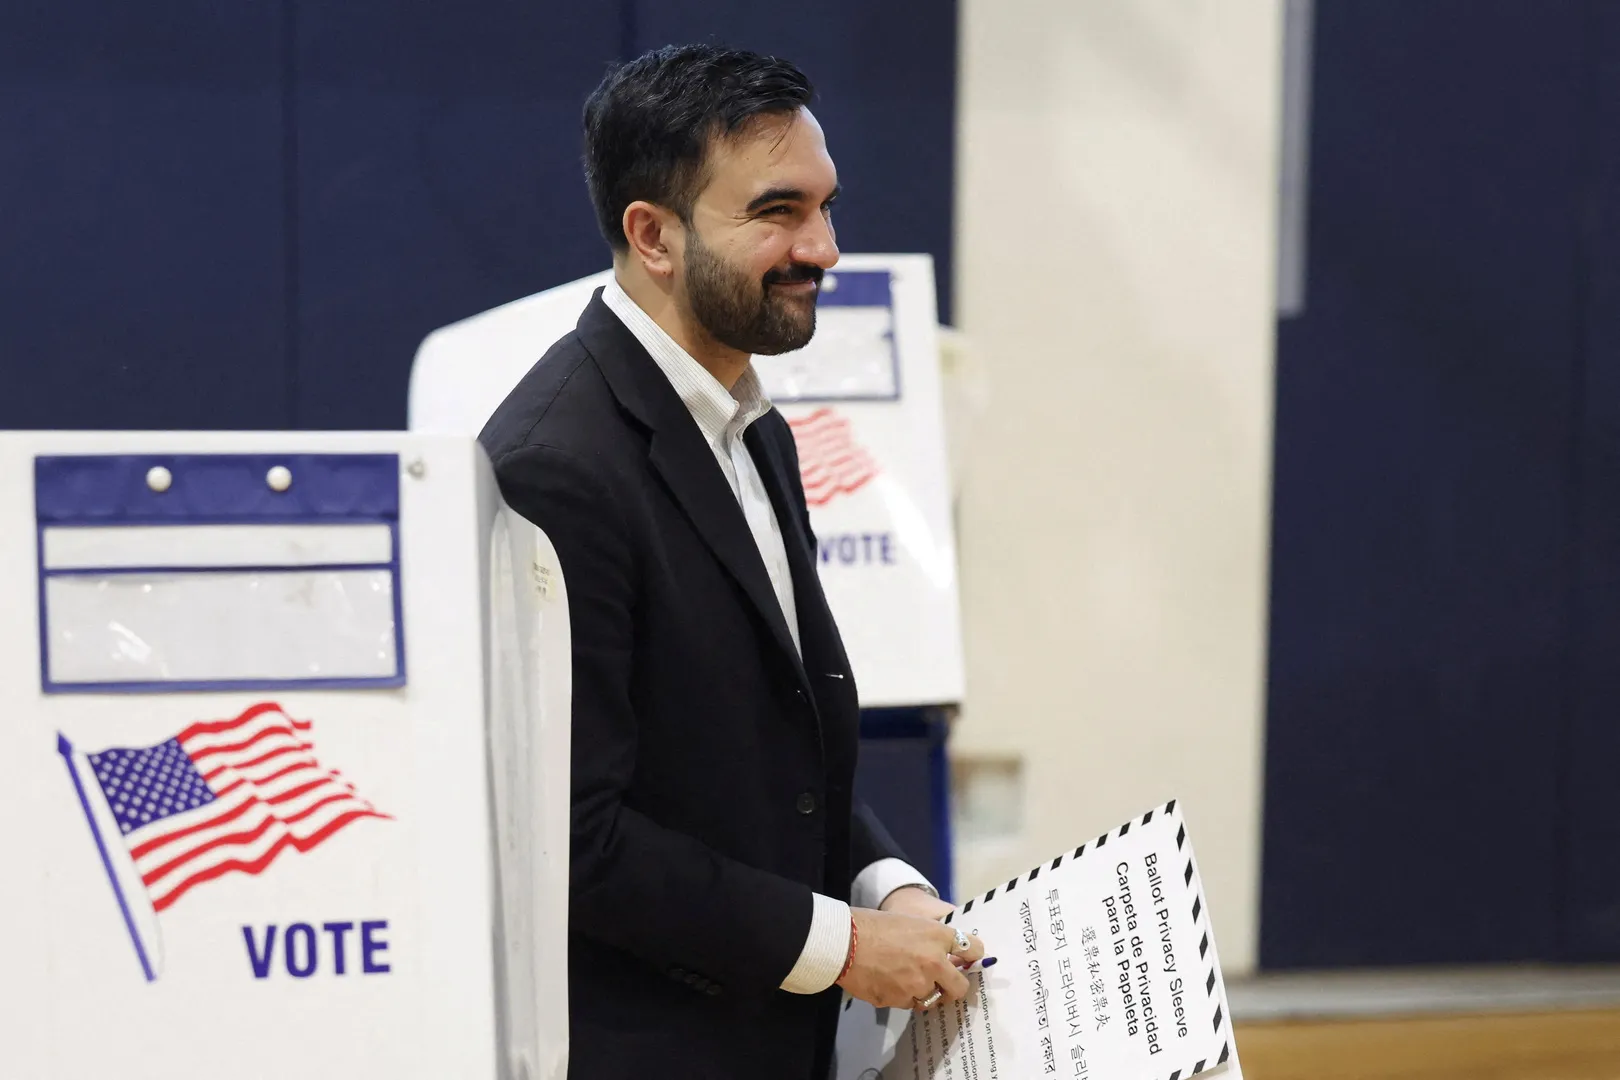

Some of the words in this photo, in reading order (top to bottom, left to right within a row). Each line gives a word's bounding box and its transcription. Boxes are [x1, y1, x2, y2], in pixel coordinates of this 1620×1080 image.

[817, 533, 897, 566] VOTE
[1102, 895, 1121, 936] para
[1116, 861, 1138, 932] Carpeta
[242, 920, 391, 978] VOTE
[1019, 898, 1038, 954] ব্যালটের
[1113, 938, 1125, 956] la
[1130, 936, 1143, 958] de
[1144, 852, 1165, 906] Ballot
[1156, 908, 1177, 974] Privacy
[1169, 978, 1188, 1038] Sleeve
[1045, 888, 1068, 951] 투표용지
[1058, 957, 1082, 1038] 프라이버시
[1081, 926, 1111, 1032] 選票私密票夾
[978, 971, 990, 1021] nstructions
[1028, 959, 1050, 1030] গোপনীয়তা
[1117, 959, 1139, 1037] Papeleta
[1136, 961, 1162, 1055] Privacidad
[960, 1041, 965, 1053] su
[985, 1022, 992, 1034] on
[987, 1036, 997, 1073] marking
[1040, 1033, 1056, 1074] রক্ষার
